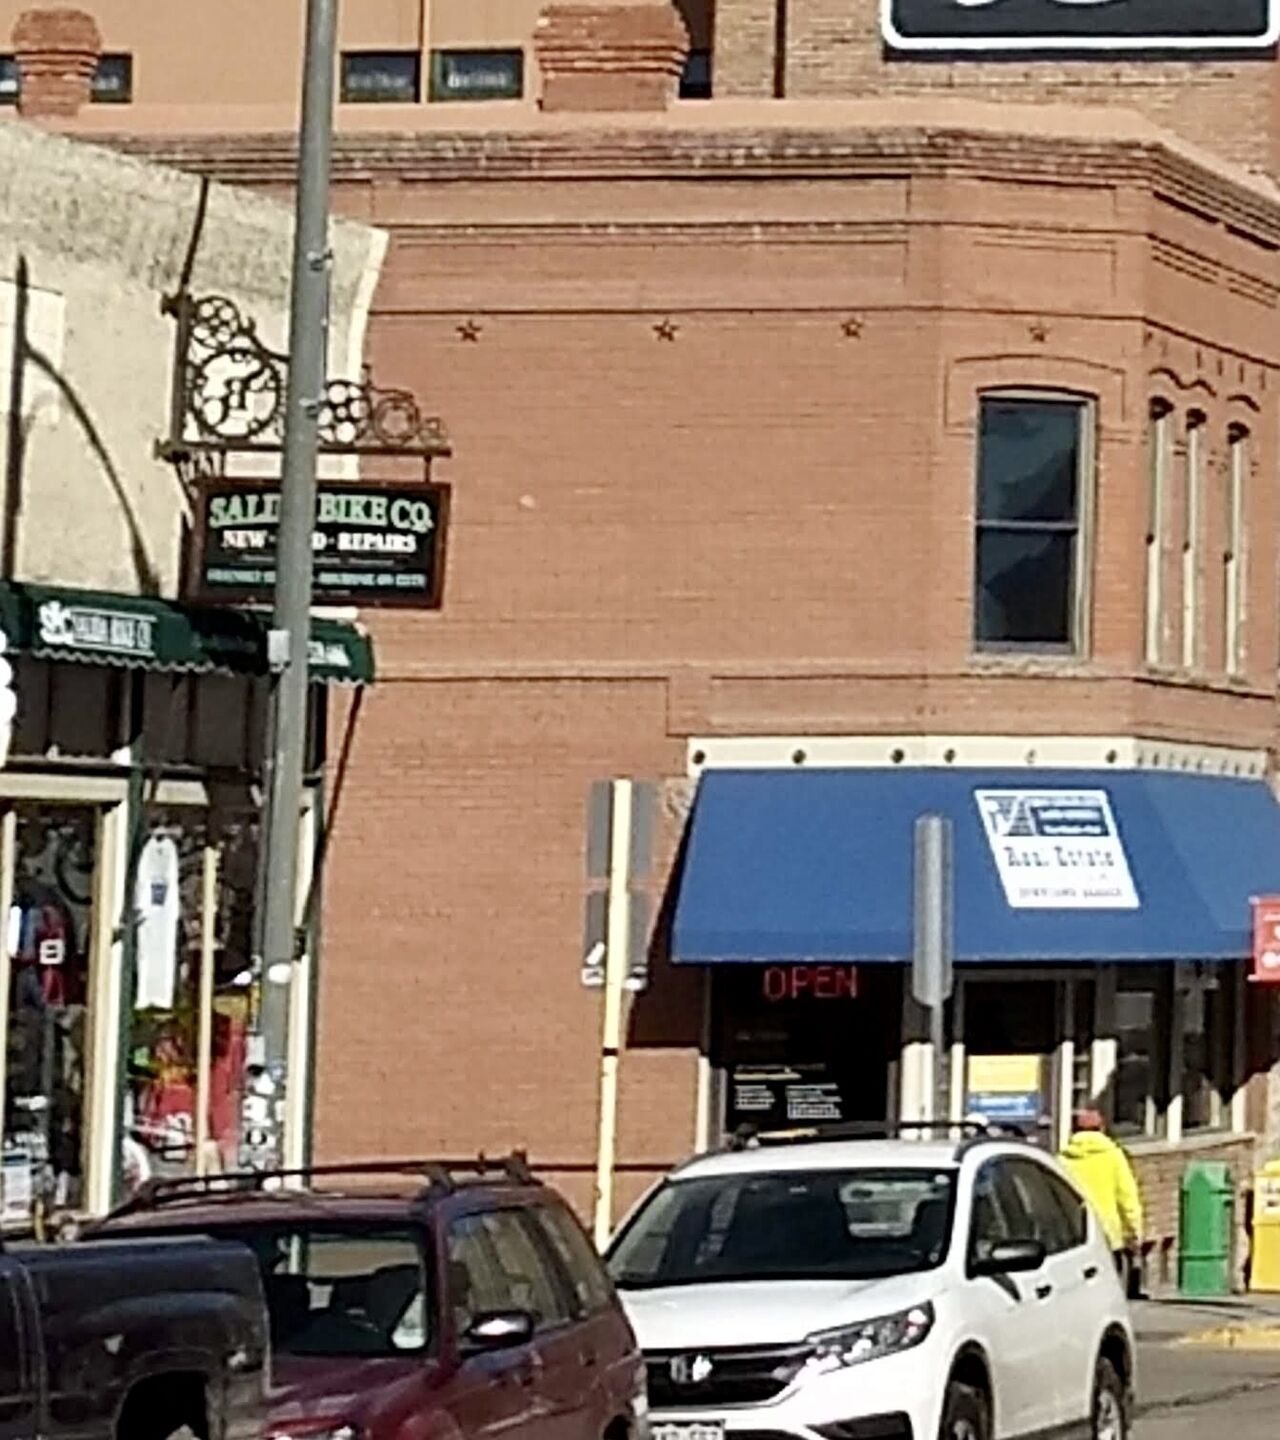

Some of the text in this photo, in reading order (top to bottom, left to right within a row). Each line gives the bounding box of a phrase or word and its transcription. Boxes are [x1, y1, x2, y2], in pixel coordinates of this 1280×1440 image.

[209, 493, 281, 527] SALI
[318, 493, 388, 526] BIKE
[221, 530, 268, 549] NEW
[337, 532, 417, 553] REPAIRS
[764, 965, 857, 1001] OPEN
